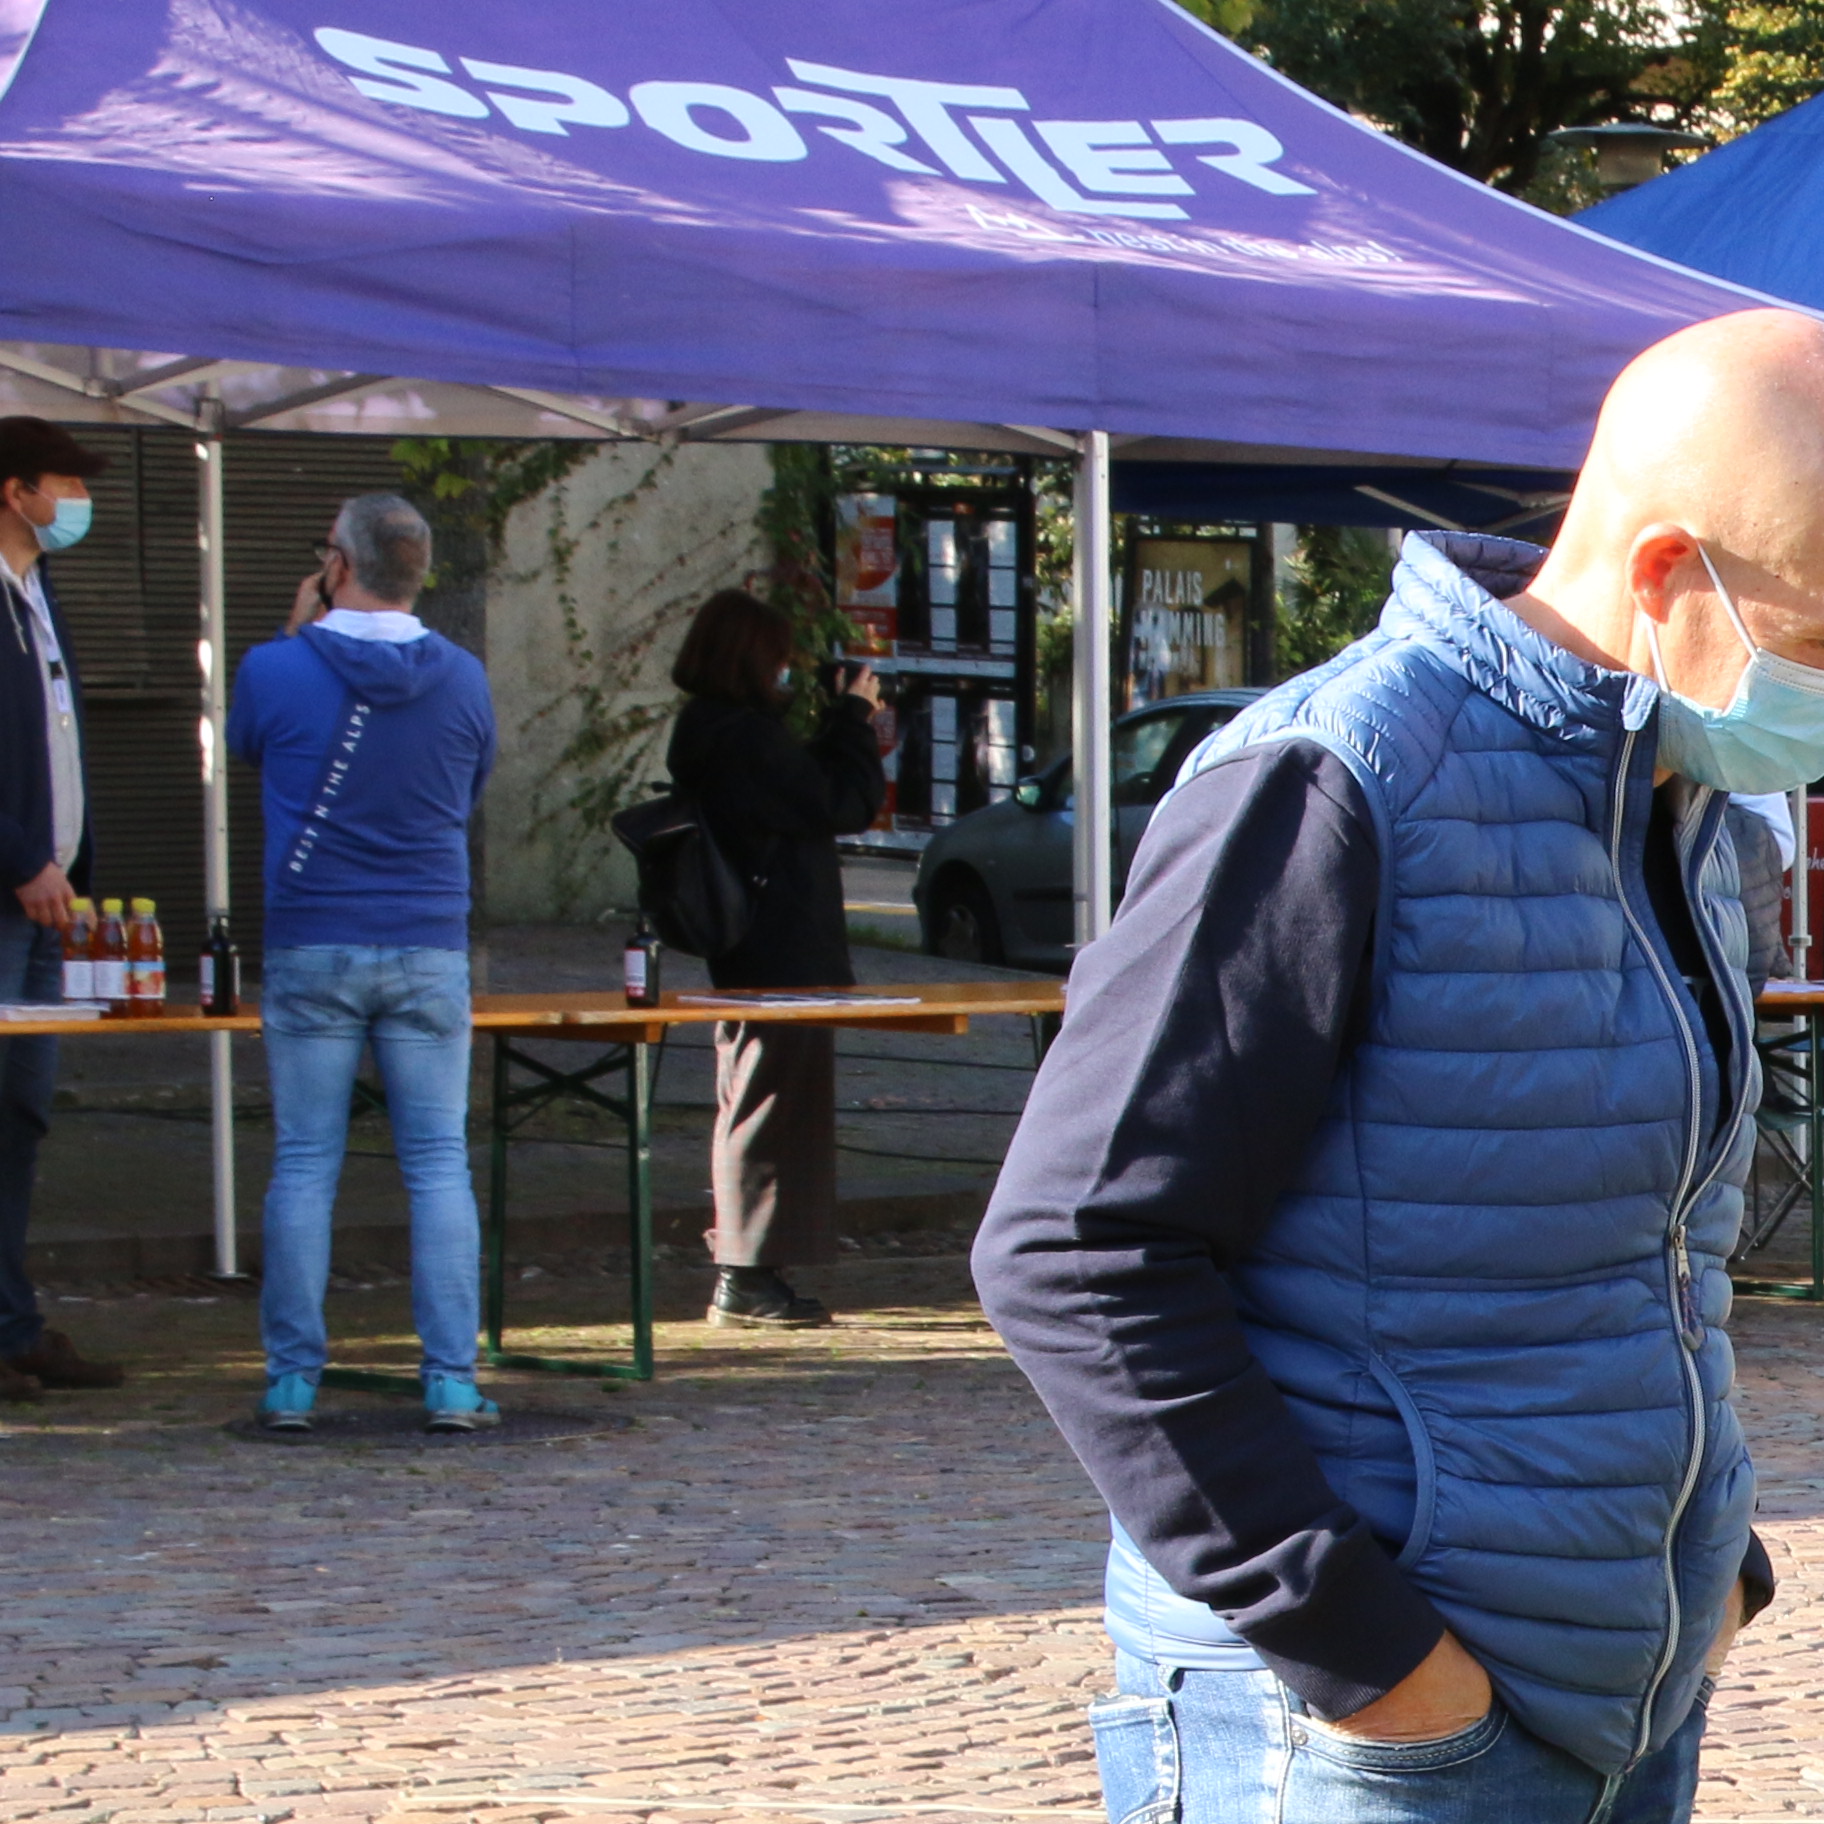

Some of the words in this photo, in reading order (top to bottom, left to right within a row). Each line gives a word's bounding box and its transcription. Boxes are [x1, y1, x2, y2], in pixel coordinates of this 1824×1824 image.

[314, 27, 1317, 219] SPORTLER
[1135, 610, 1227, 648] MMING
[1142, 569, 1203, 606] PALAIS
[289, 827, 319, 873] BEST
[314, 804, 330, 820] N
[322, 759, 349, 796] THE
[342, 703, 371, 753] ALPS
